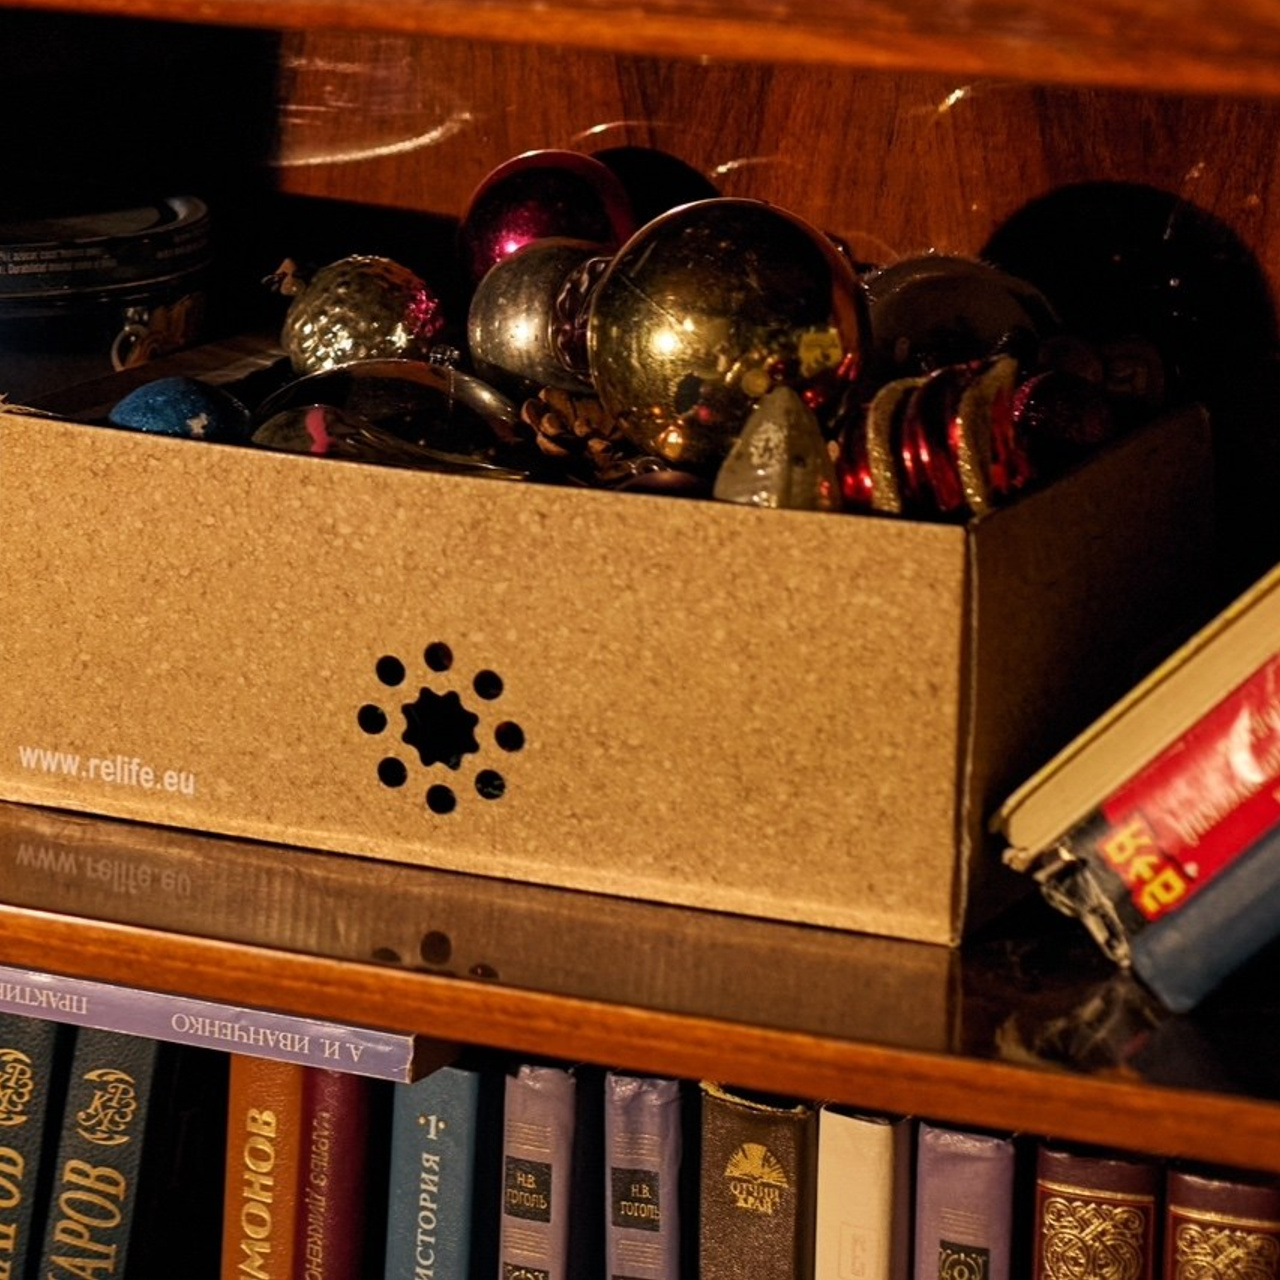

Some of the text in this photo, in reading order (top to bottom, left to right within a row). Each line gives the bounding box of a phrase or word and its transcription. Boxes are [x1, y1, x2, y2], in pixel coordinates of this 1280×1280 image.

[18, 745, 196, 796] www.relife.eu
[171, 1012, 310, 1054] ИВАНЧЕНКО
[238, 1107, 277, 1280] МОНОВ
[507, 1188, 549, 1210] ГОГОЛЬ
[620, 1201, 661, 1220] ГОГОЛЬ
[47, 1158, 127, 1280] АРОВ
